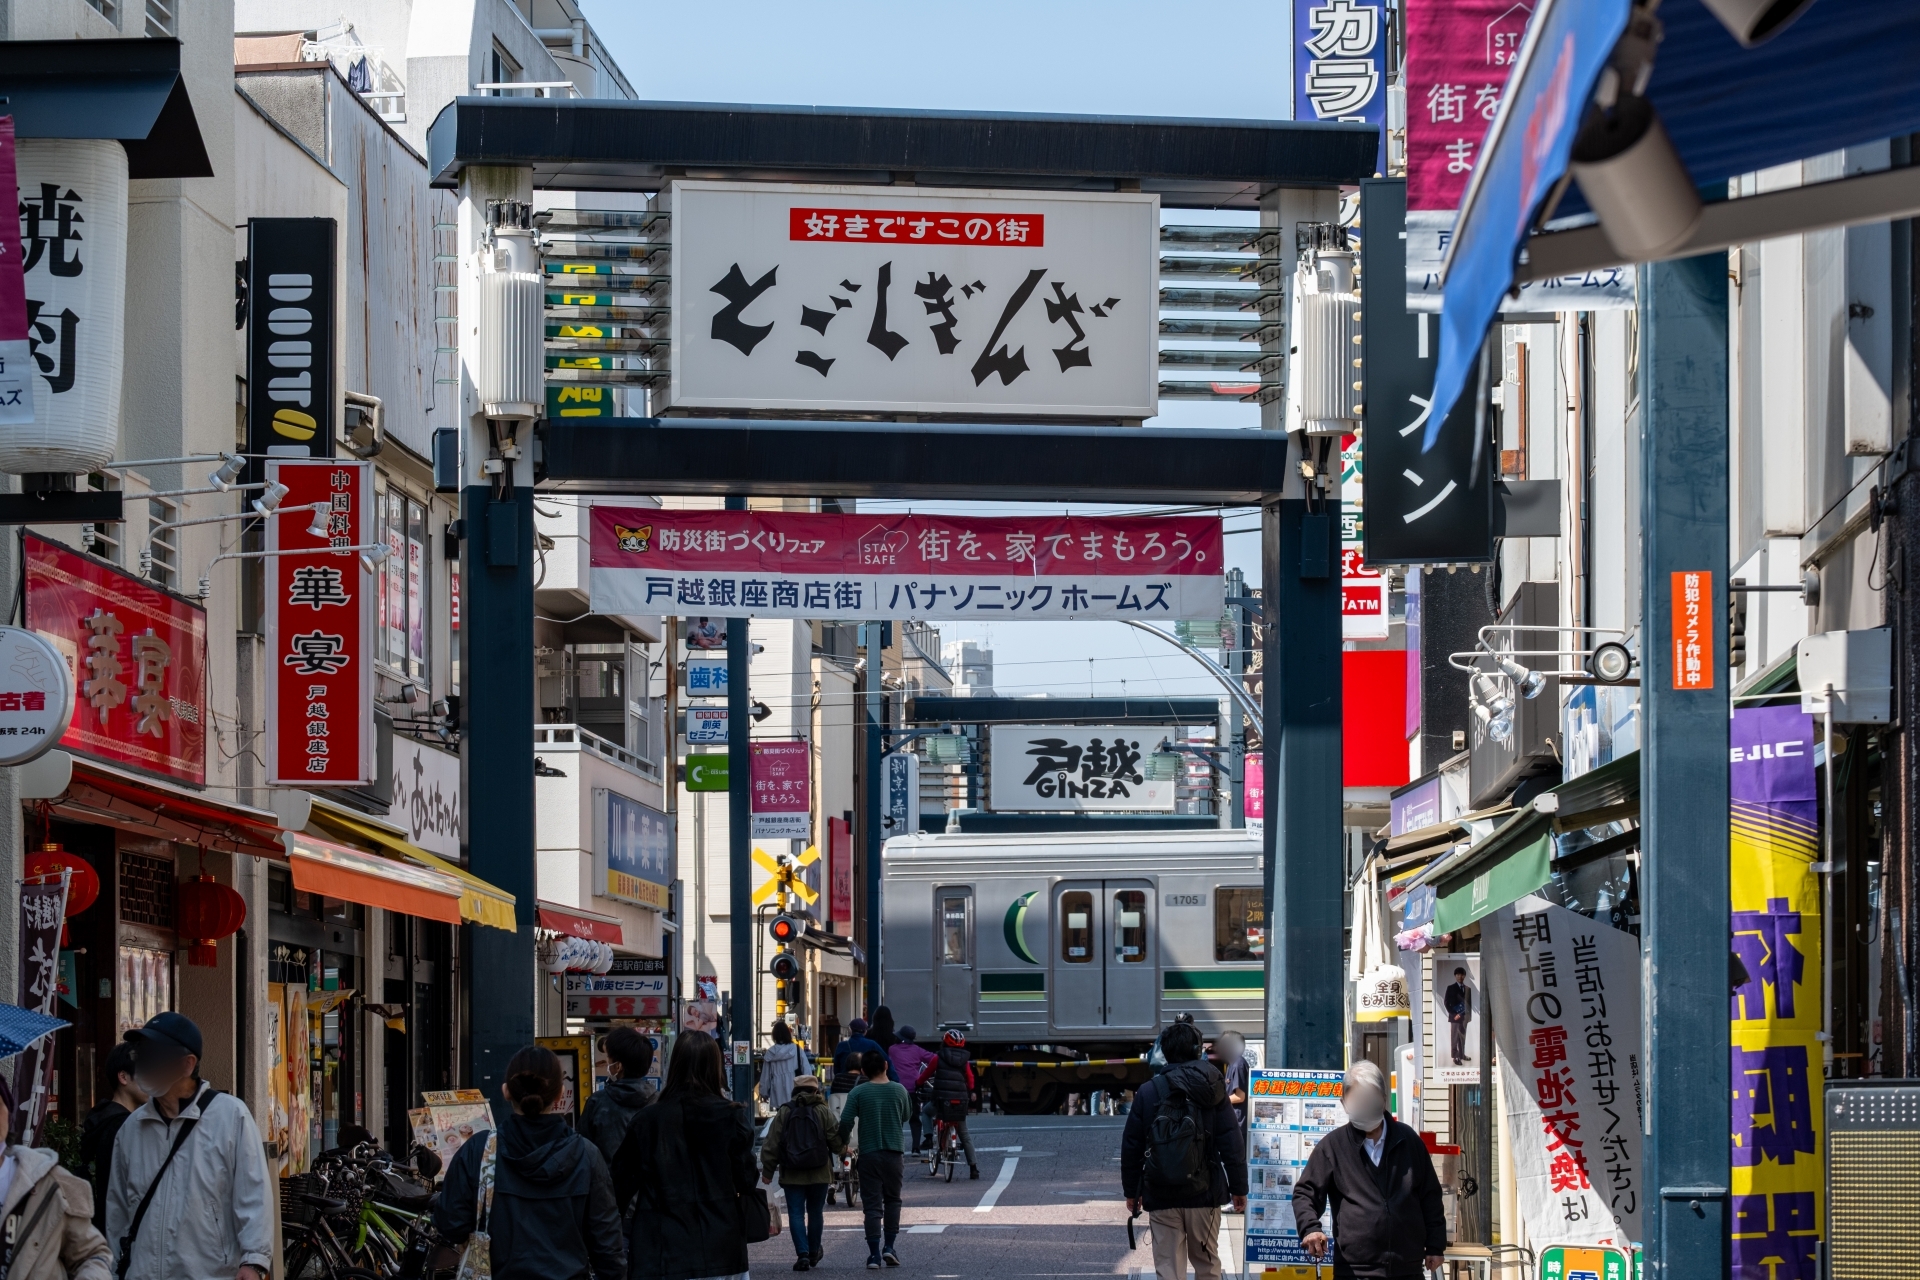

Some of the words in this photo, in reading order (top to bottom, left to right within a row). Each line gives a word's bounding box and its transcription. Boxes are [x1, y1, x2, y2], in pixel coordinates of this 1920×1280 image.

[803, 211, 1030, 243] 好きですこの街
[708, 258, 1122, 388] とごしぎんざ
[266, 273, 317, 458] DOUTO
[329, 469, 352, 557] 中国料理
[659, 528, 826, 554] 防災街づくりフェア
[863, 542, 897, 553] STAY
[917, 528, 1206, 564] 街を、家でまもろう。
[863, 554, 897, 565] SAFE
[645, 575, 863, 610] 戸越銀座商店街
[889, 581, 1054, 612] パナソニック
[1061, 581, 1173, 613] ホームズ
[284, 565, 352, 676] 華宴
[1684, 573, 1702, 686] 防犯カメラ作動中
[21, 726, 46, 736] 24h
[305, 683, 330, 773] 戸越銀座店
[1022, 736, 1144, 786] 戸越
[755, 780, 805, 791] 街を、家で
[760, 793, 801, 804] まもろう。
[1034, 772, 1132, 799] GINZA
[1172, 895, 1199, 905] 1705
[593, 979, 664, 992] 創英ゼミナール
[1376, 980, 1402, 994] 全身
[588, 996, 663, 1016] 美容室
